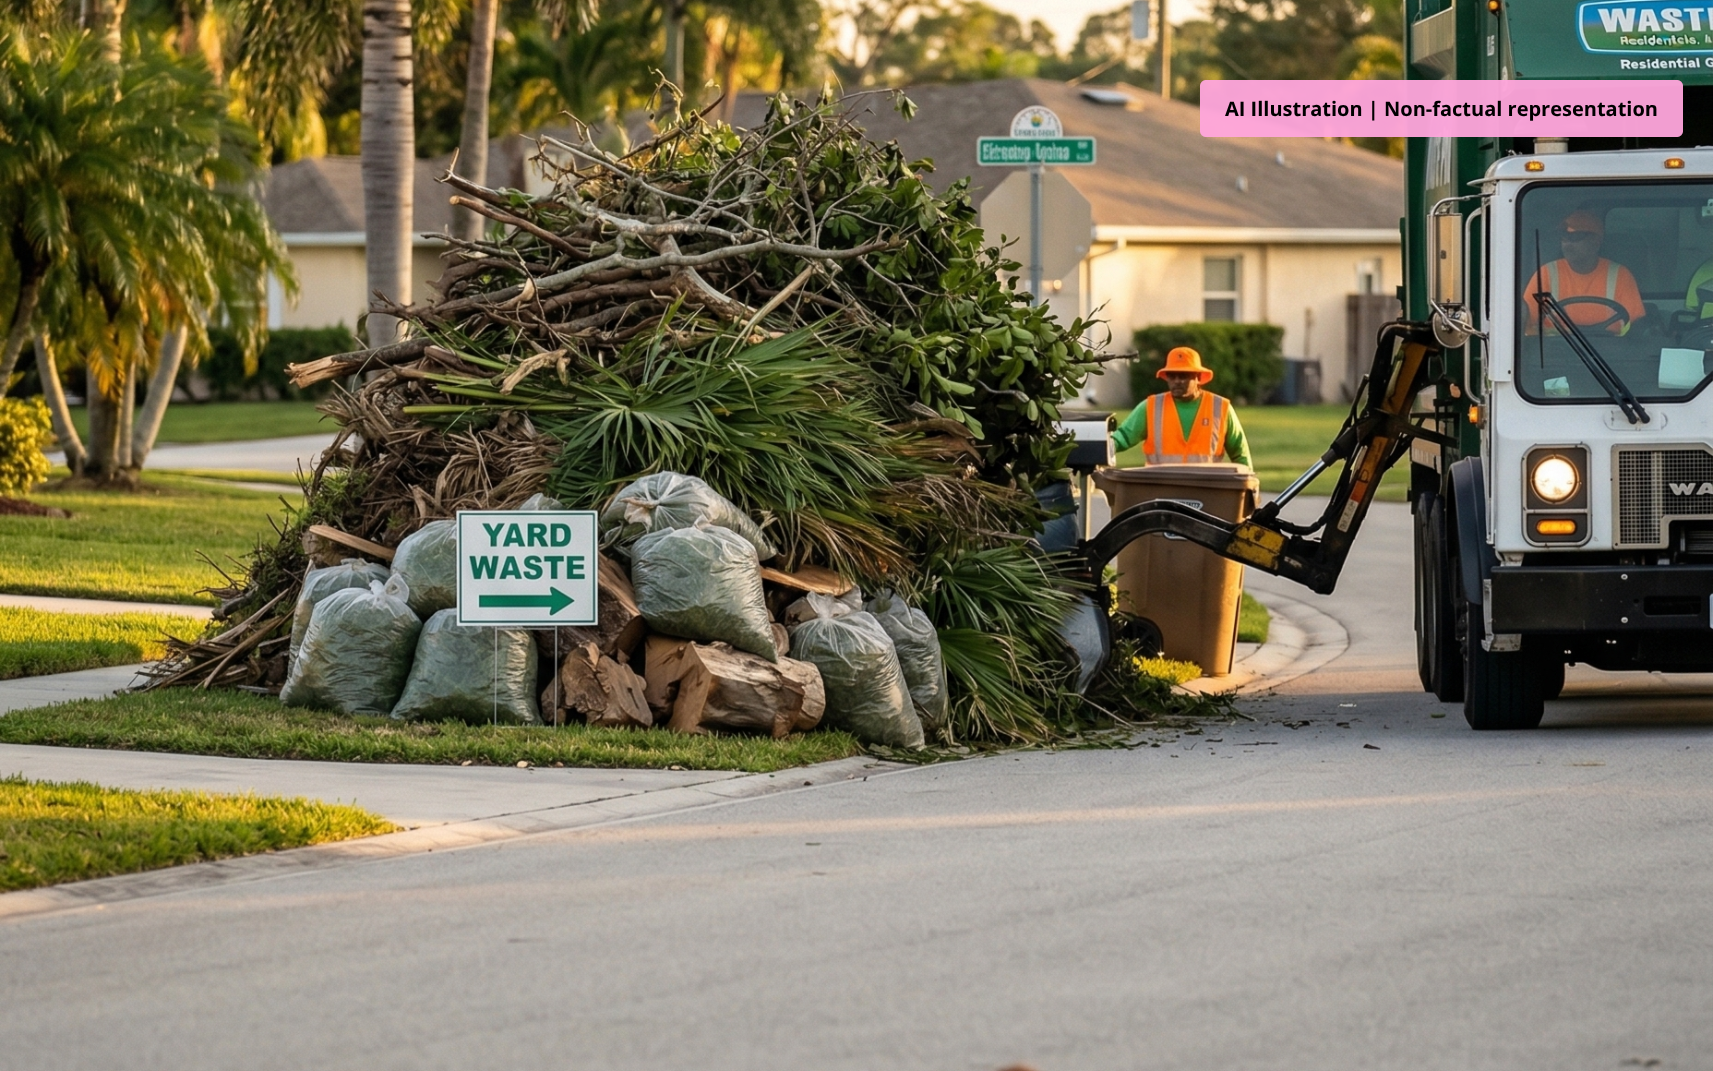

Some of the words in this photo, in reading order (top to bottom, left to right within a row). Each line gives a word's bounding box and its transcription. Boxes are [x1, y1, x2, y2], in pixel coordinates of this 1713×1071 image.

[1620, 57, 1701, 70] Residential
[482, 523, 572, 548] YARD
[469, 555, 586, 580] WASTE
